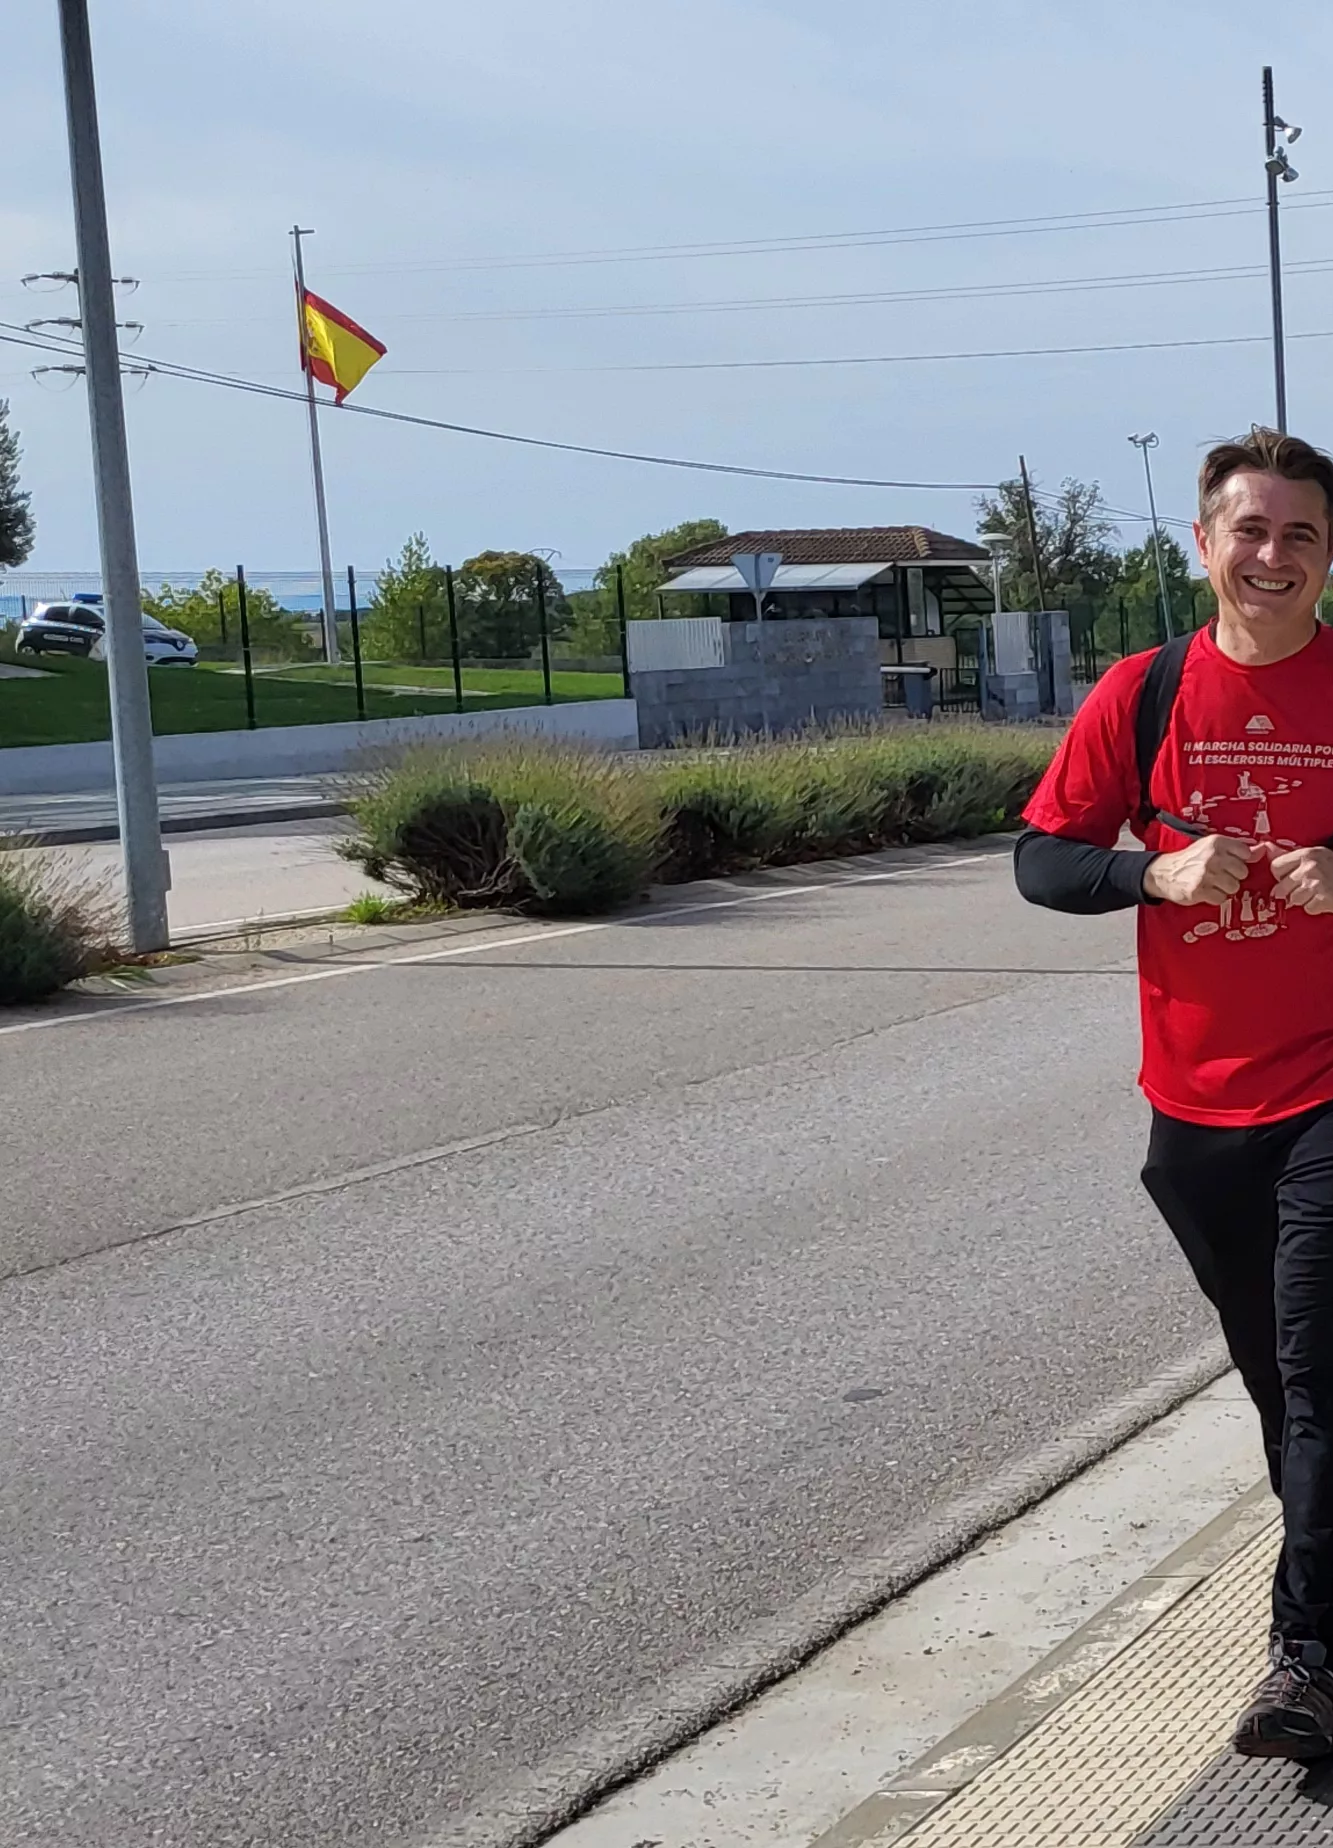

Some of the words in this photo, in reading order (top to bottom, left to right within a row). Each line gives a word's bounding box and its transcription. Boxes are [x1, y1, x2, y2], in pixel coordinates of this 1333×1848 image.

[1183, 741, 1192, 751] II
[1192, 741, 1246, 752] MARCHA
[1247, 742, 1312, 754] SOLIDARIA
[1188, 754, 1203, 765] LA
[1204, 754, 1275, 765] ESCLEROSIS
